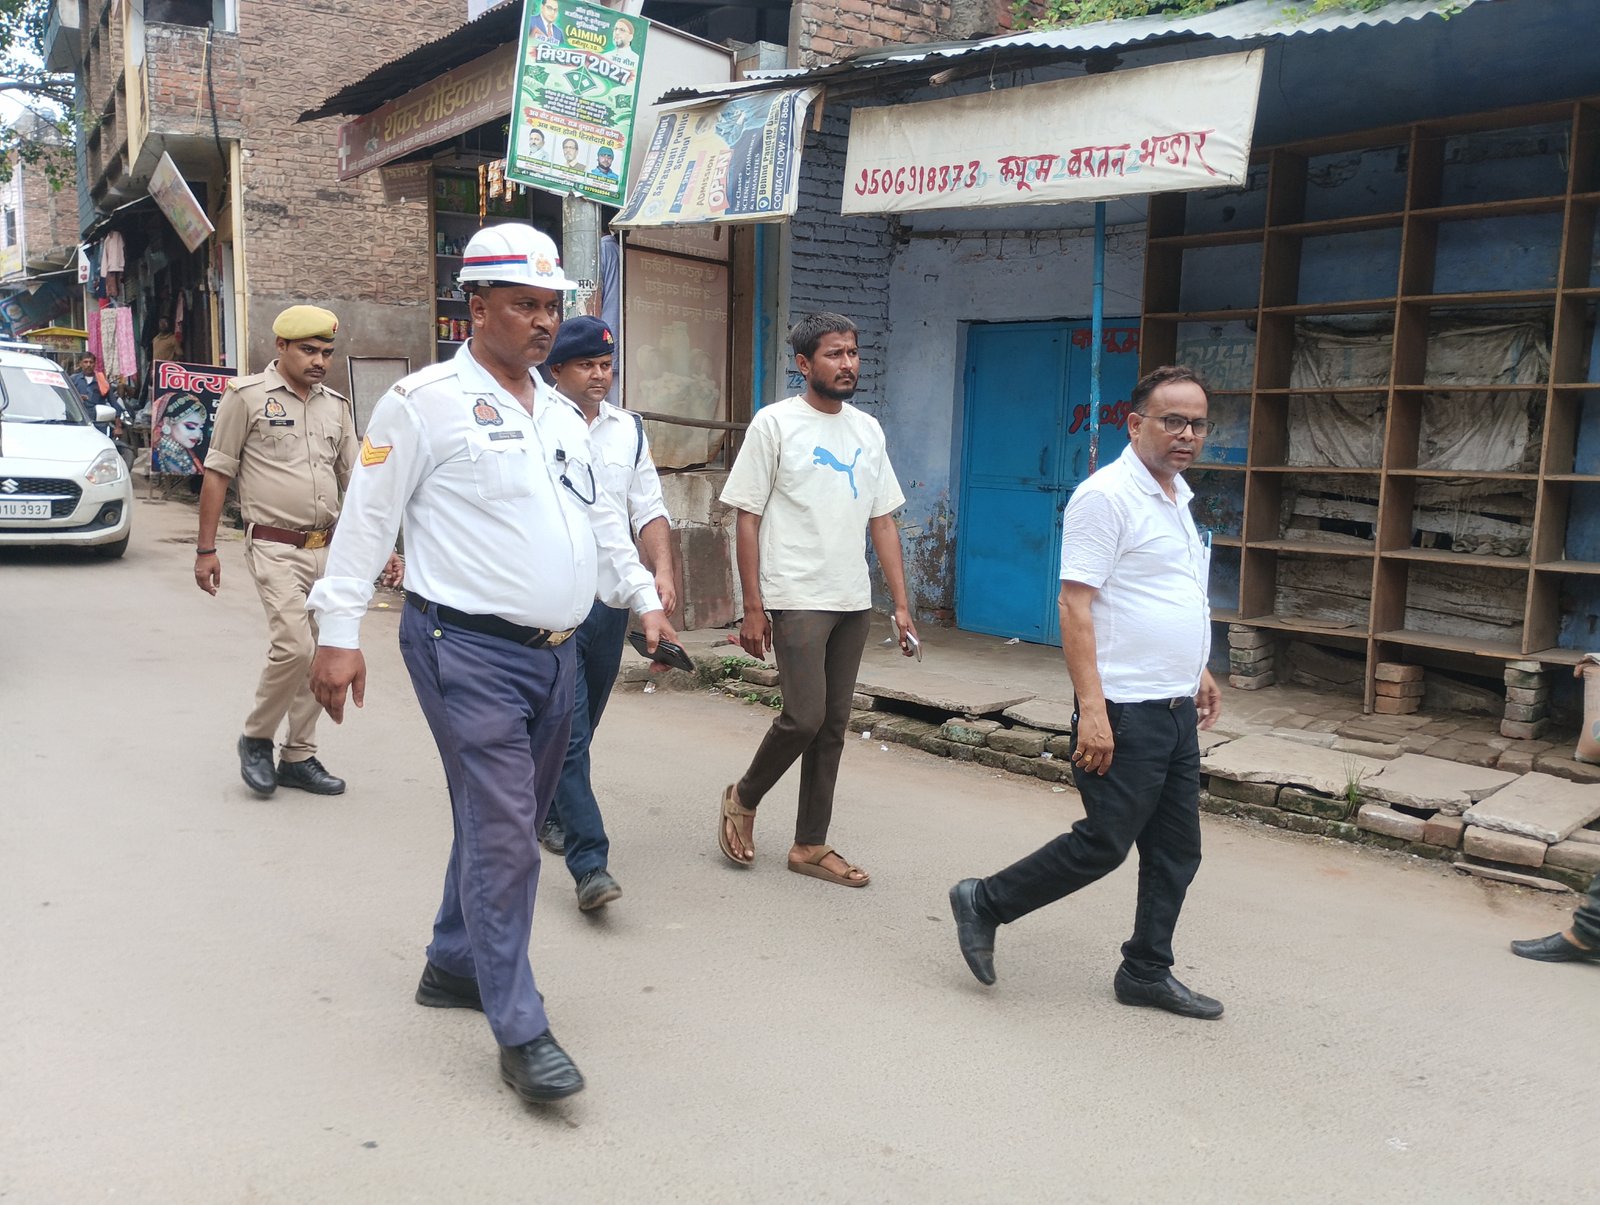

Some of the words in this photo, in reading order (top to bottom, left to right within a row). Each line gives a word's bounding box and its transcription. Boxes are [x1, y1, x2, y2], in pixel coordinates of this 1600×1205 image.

[565, 24, 607, 47] (AIMIM)
[536, 43, 587, 67] मिशन
[587, 55, 631, 86] 2027
[651, 116, 671, 151] SCHOOL
[776, 139, 787, 166] NOW:
[708, 150, 733, 207] OPEN
[773, 166, 784, 210] CONTACT
[854, 160, 980, 196] 9506918373
[0, 504, 17, 515] 1U
[20, 504, 48, 515] 3937
